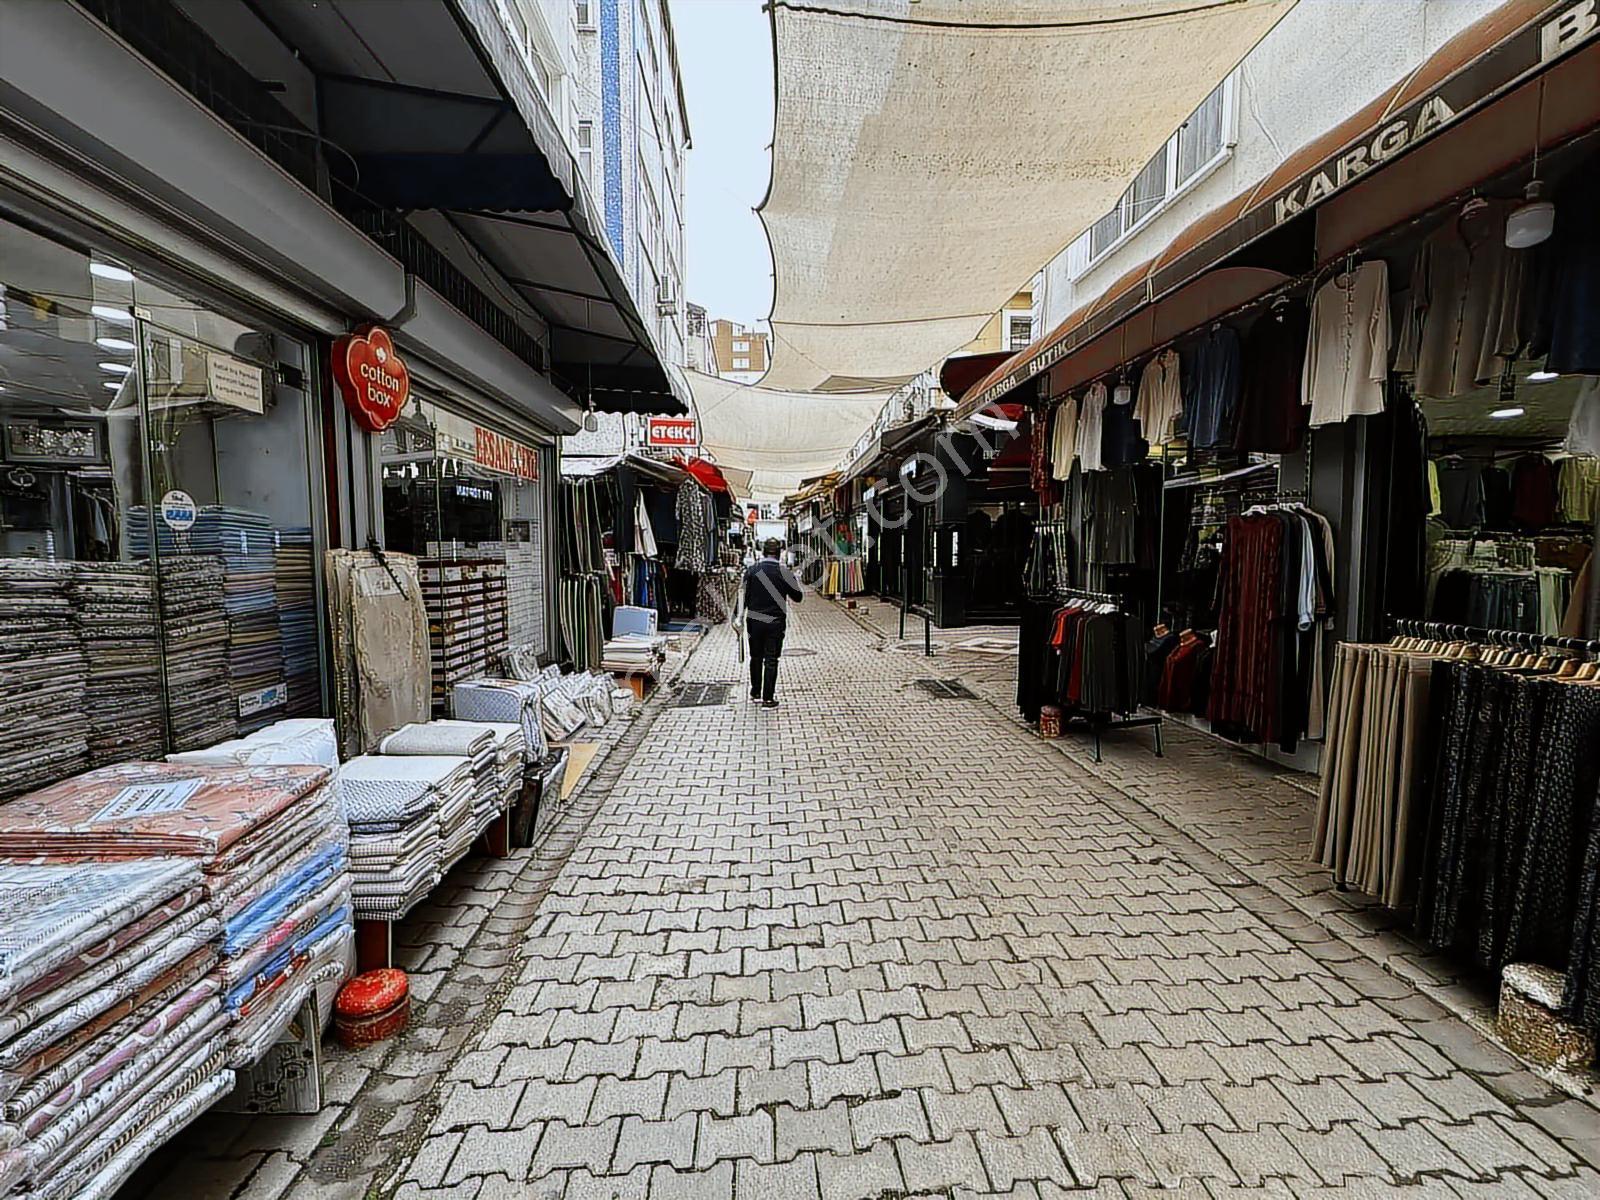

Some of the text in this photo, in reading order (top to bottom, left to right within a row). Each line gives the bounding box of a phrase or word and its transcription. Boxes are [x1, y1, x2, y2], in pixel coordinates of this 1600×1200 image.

[1275, 96, 1455, 225] KARGA
[361, 363, 399, 392] cotton
[984, 375, 1017, 402] KARGA
[368, 382, 391, 408] box
